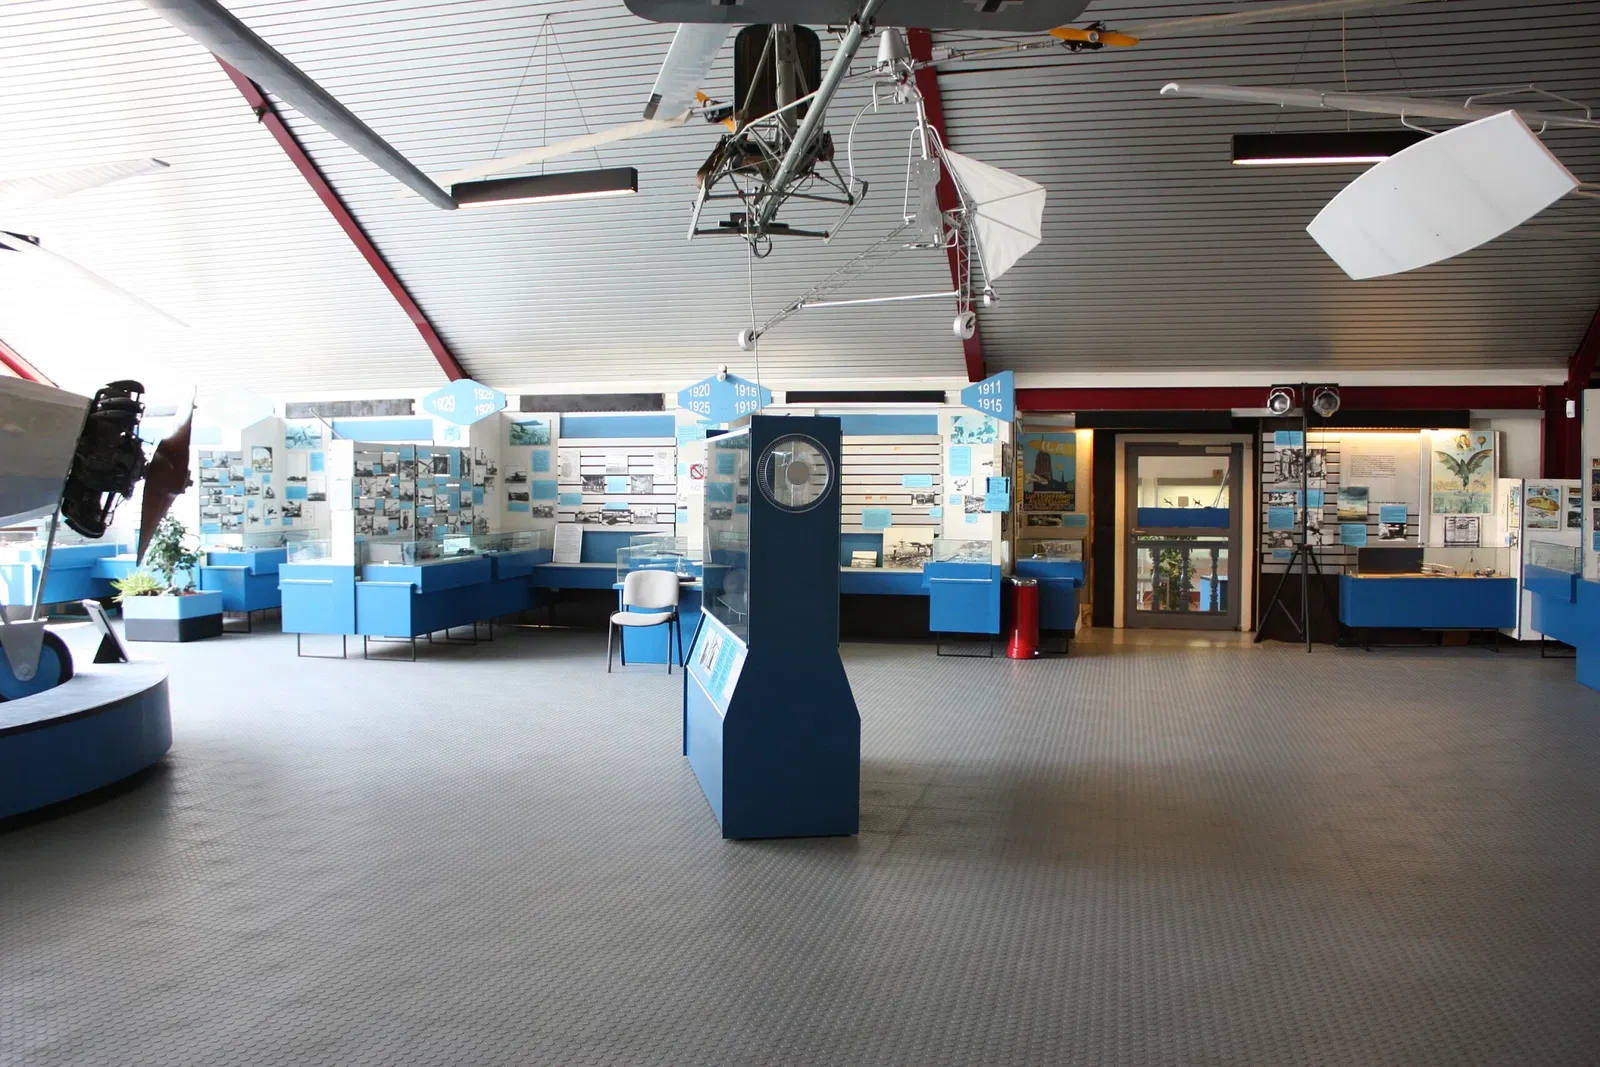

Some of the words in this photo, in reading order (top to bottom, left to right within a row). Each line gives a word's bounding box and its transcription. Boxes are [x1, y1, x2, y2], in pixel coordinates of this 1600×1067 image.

[688, 383, 710, 398] 1920
[734, 383, 757, 397] 1915
[977, 379, 1000, 395] 1911
[688, 400, 711, 414] 1925
[734, 399, 757, 415] 1919
[977, 398, 1002, 413] 1915
